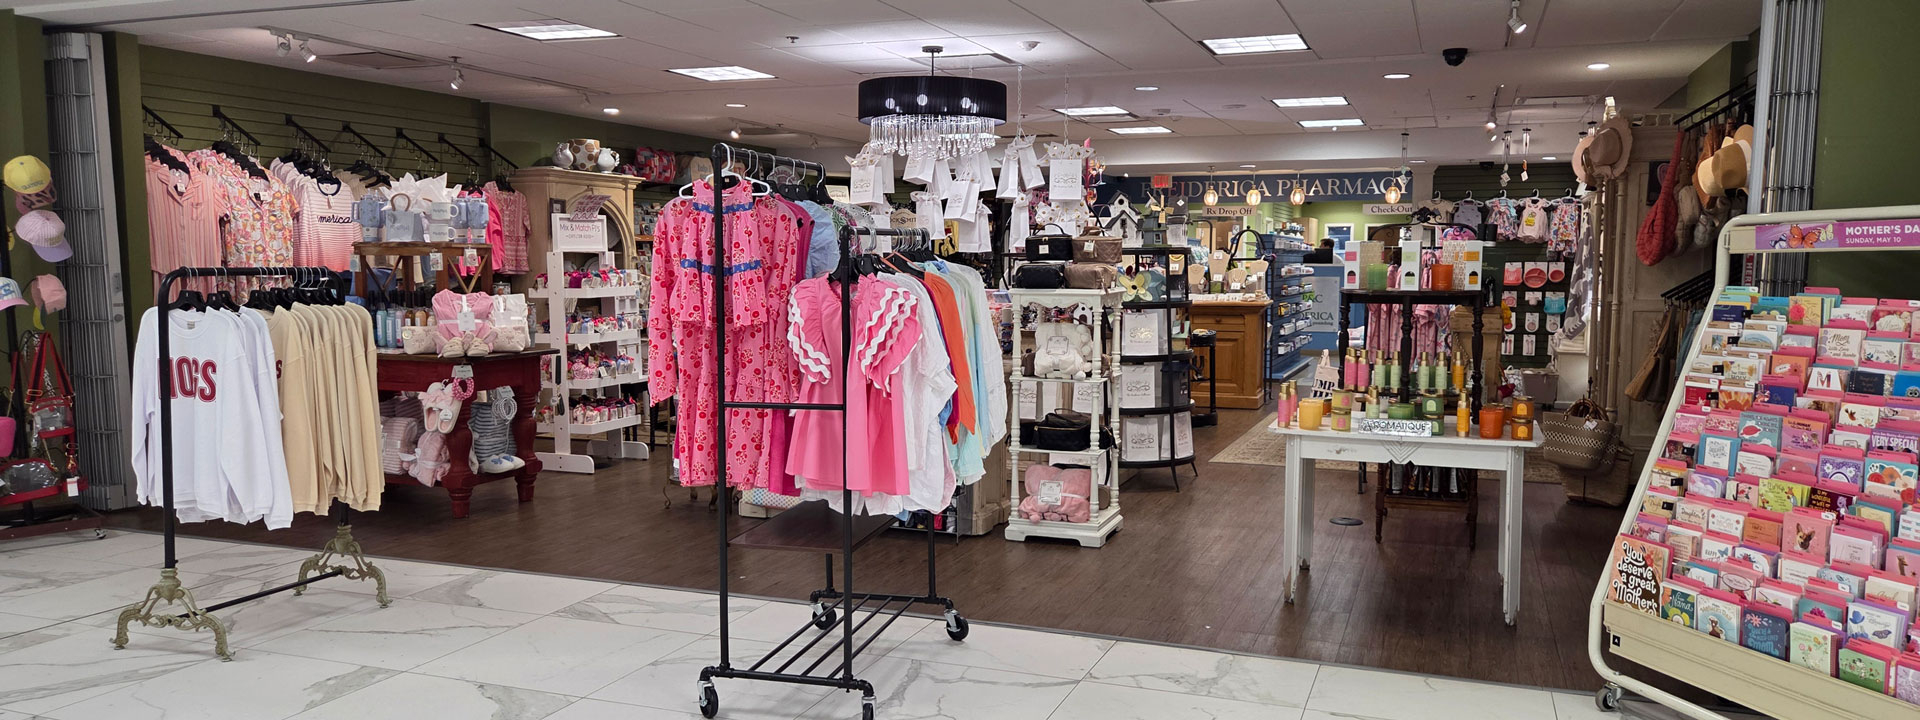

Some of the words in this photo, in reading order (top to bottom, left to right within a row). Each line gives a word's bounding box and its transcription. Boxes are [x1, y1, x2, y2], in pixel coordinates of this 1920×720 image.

[1277, 177, 1412, 197] PHARMACY
[1206, 207, 1217, 215] Rx
[1218, 207, 1238, 216] Drop
[1239, 207, 1253, 215] Off
[1370, 205, 1413, 214] Check-Out
[1845, 225, 1901, 236] MOTHER'S
[1845, 237, 1875, 245] SUNDAY,
[1362, 420, 1426, 432] AROMATIQUE
[1871, 434, 1889, 447] VERY
[1889, 437, 1919, 453] SPECIAL
[1622, 541, 1646, 566] You
[1616, 557, 1653, 580] deserve
[1621, 572, 1627, 583] a
[1628, 575, 1657, 594] great
[1612, 579, 1658, 611] Mother's
